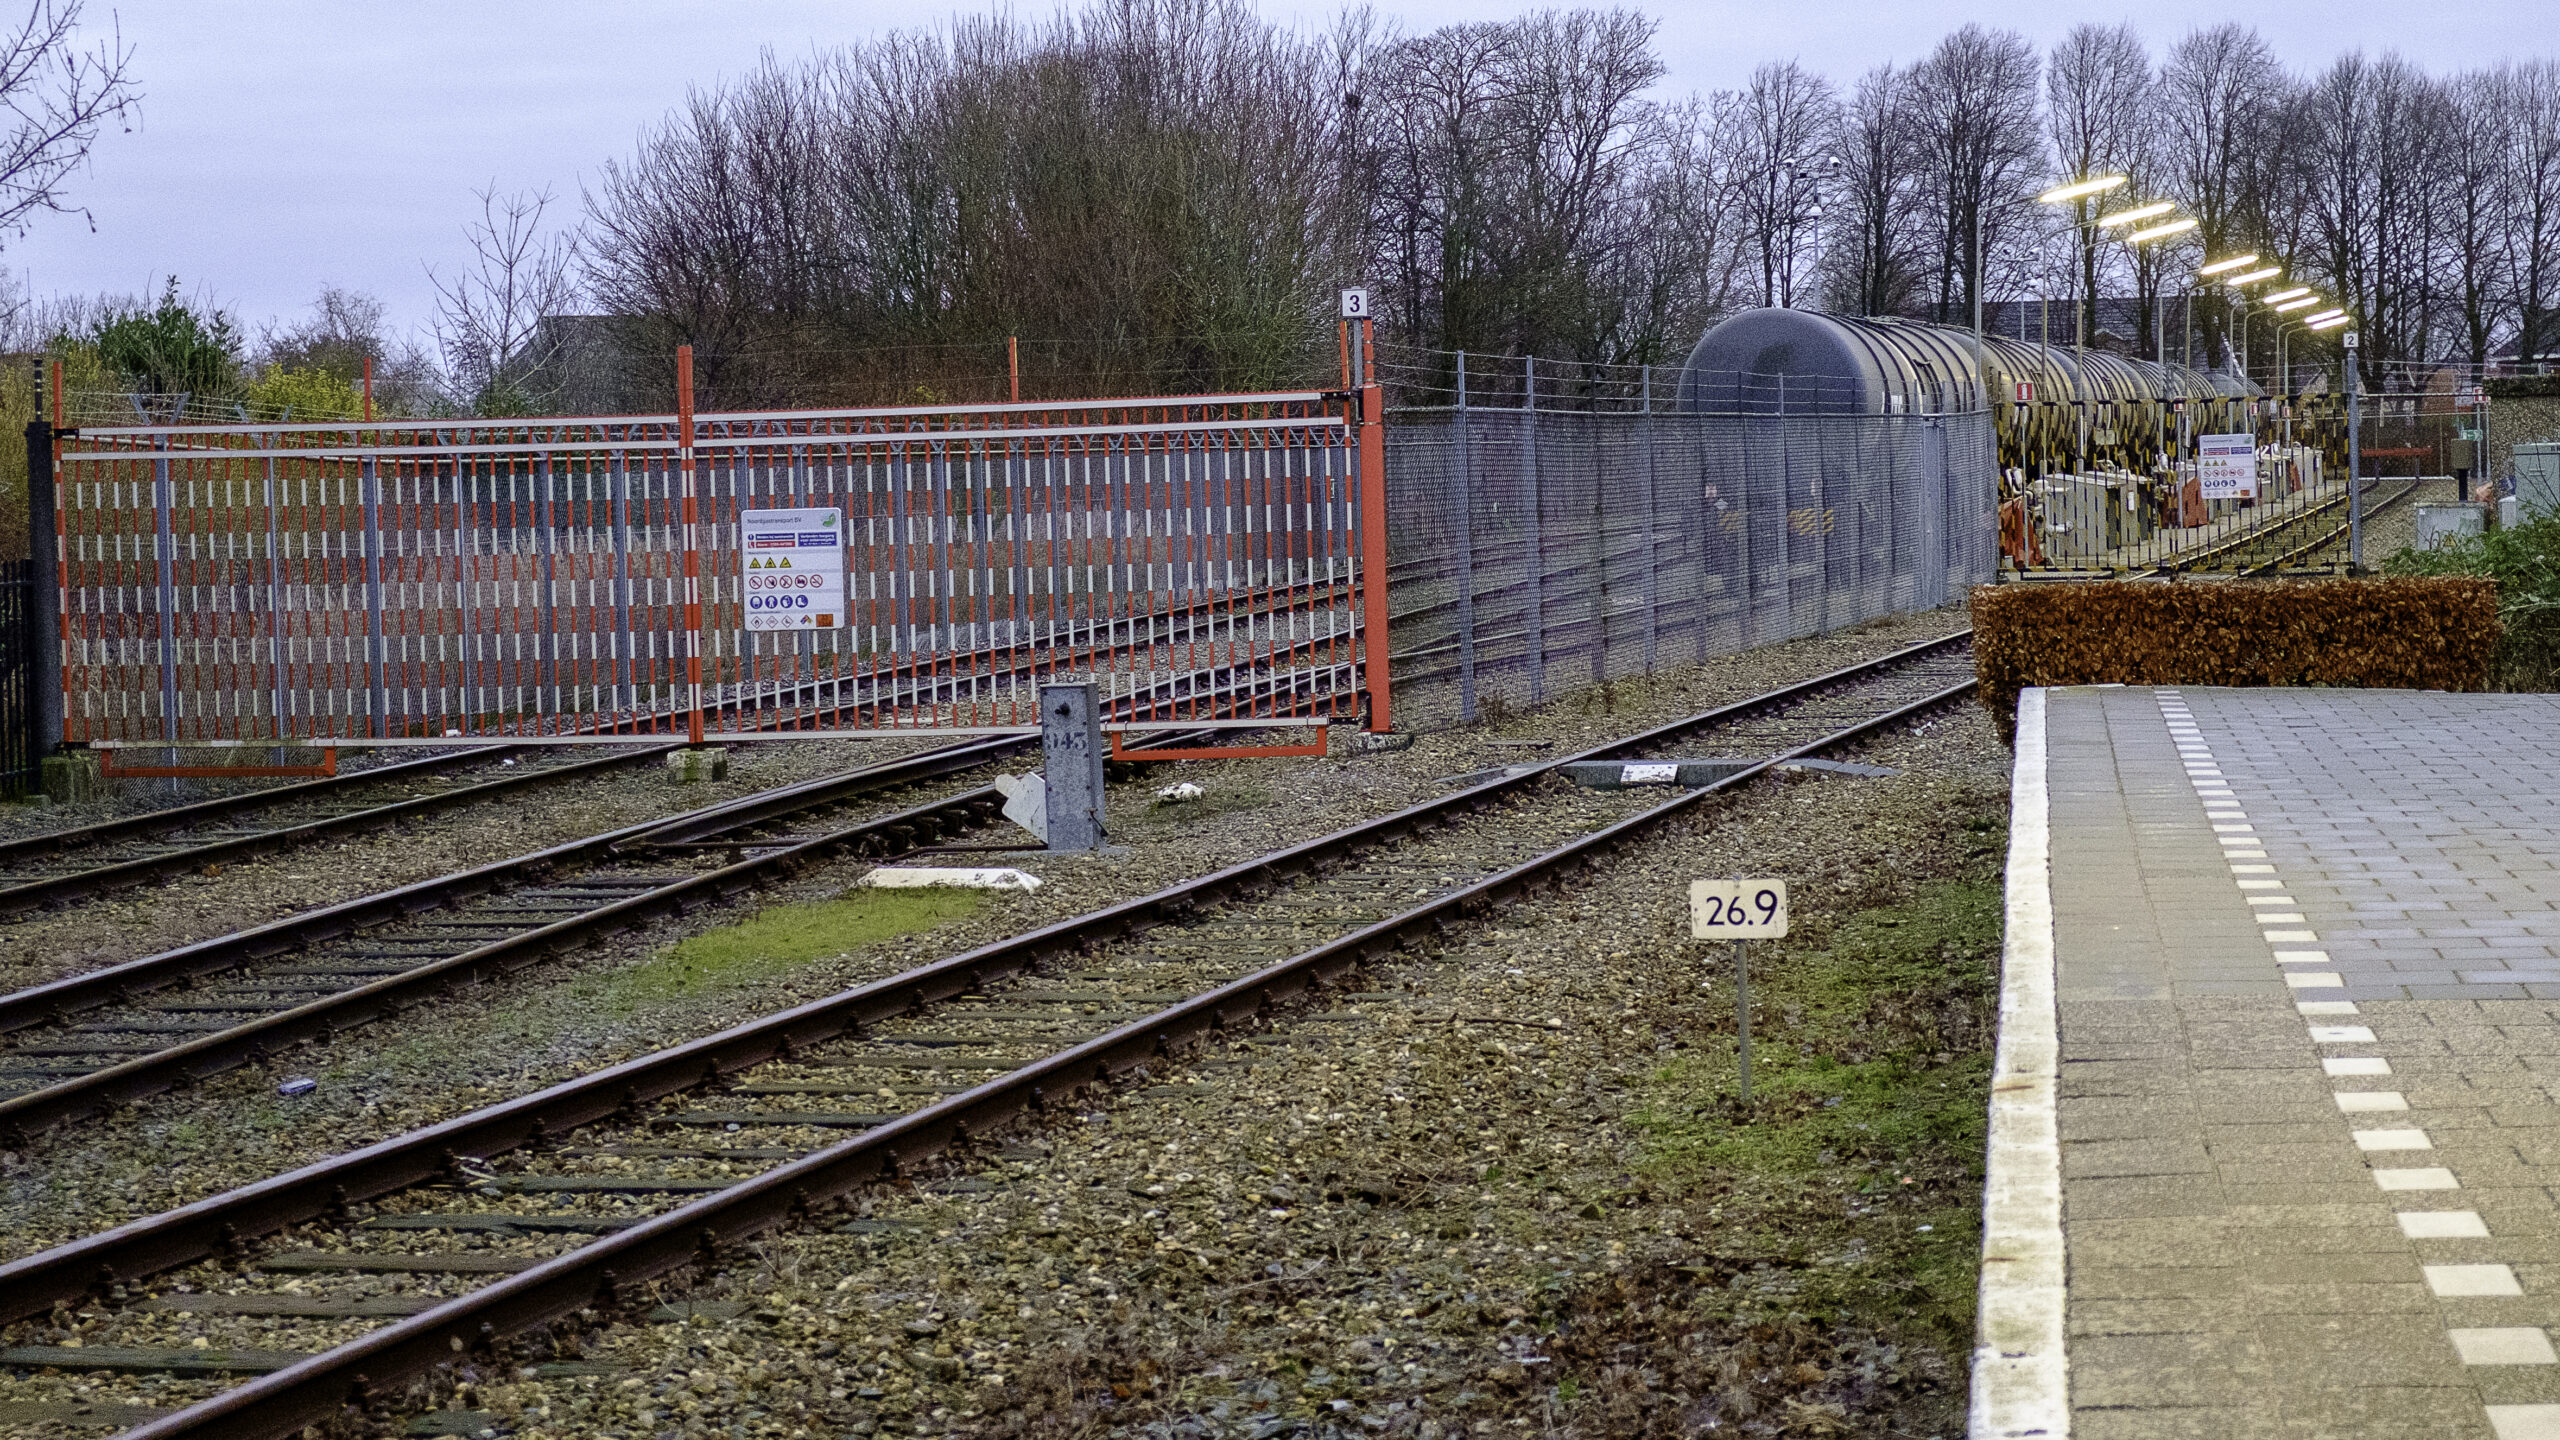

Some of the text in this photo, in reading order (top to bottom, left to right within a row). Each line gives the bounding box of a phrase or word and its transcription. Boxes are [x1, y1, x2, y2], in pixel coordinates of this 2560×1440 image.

[1350, 295, 1360, 312] 3
[2348, 335, 2354, 345] 2
[1706, 889, 1778, 926] 26.9
